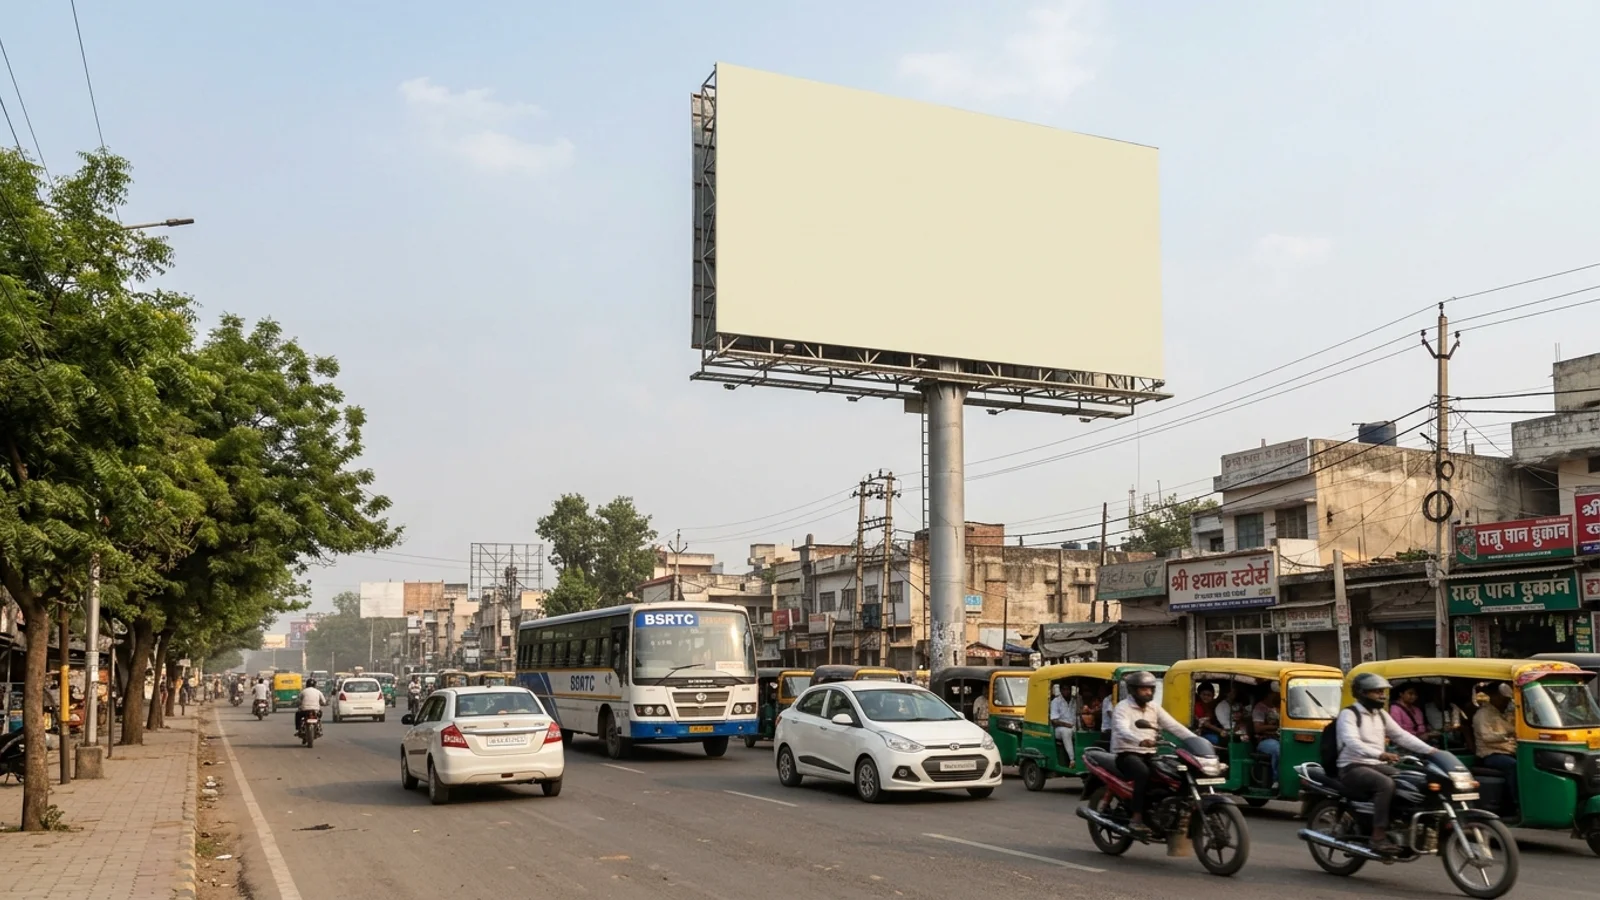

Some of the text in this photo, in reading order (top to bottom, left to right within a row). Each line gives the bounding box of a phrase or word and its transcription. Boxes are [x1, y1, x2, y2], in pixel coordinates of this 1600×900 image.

[1171, 569, 1188, 591] श्री
[1485, 582, 1515, 599] पान
[644, 613, 695, 625] BSRTC
